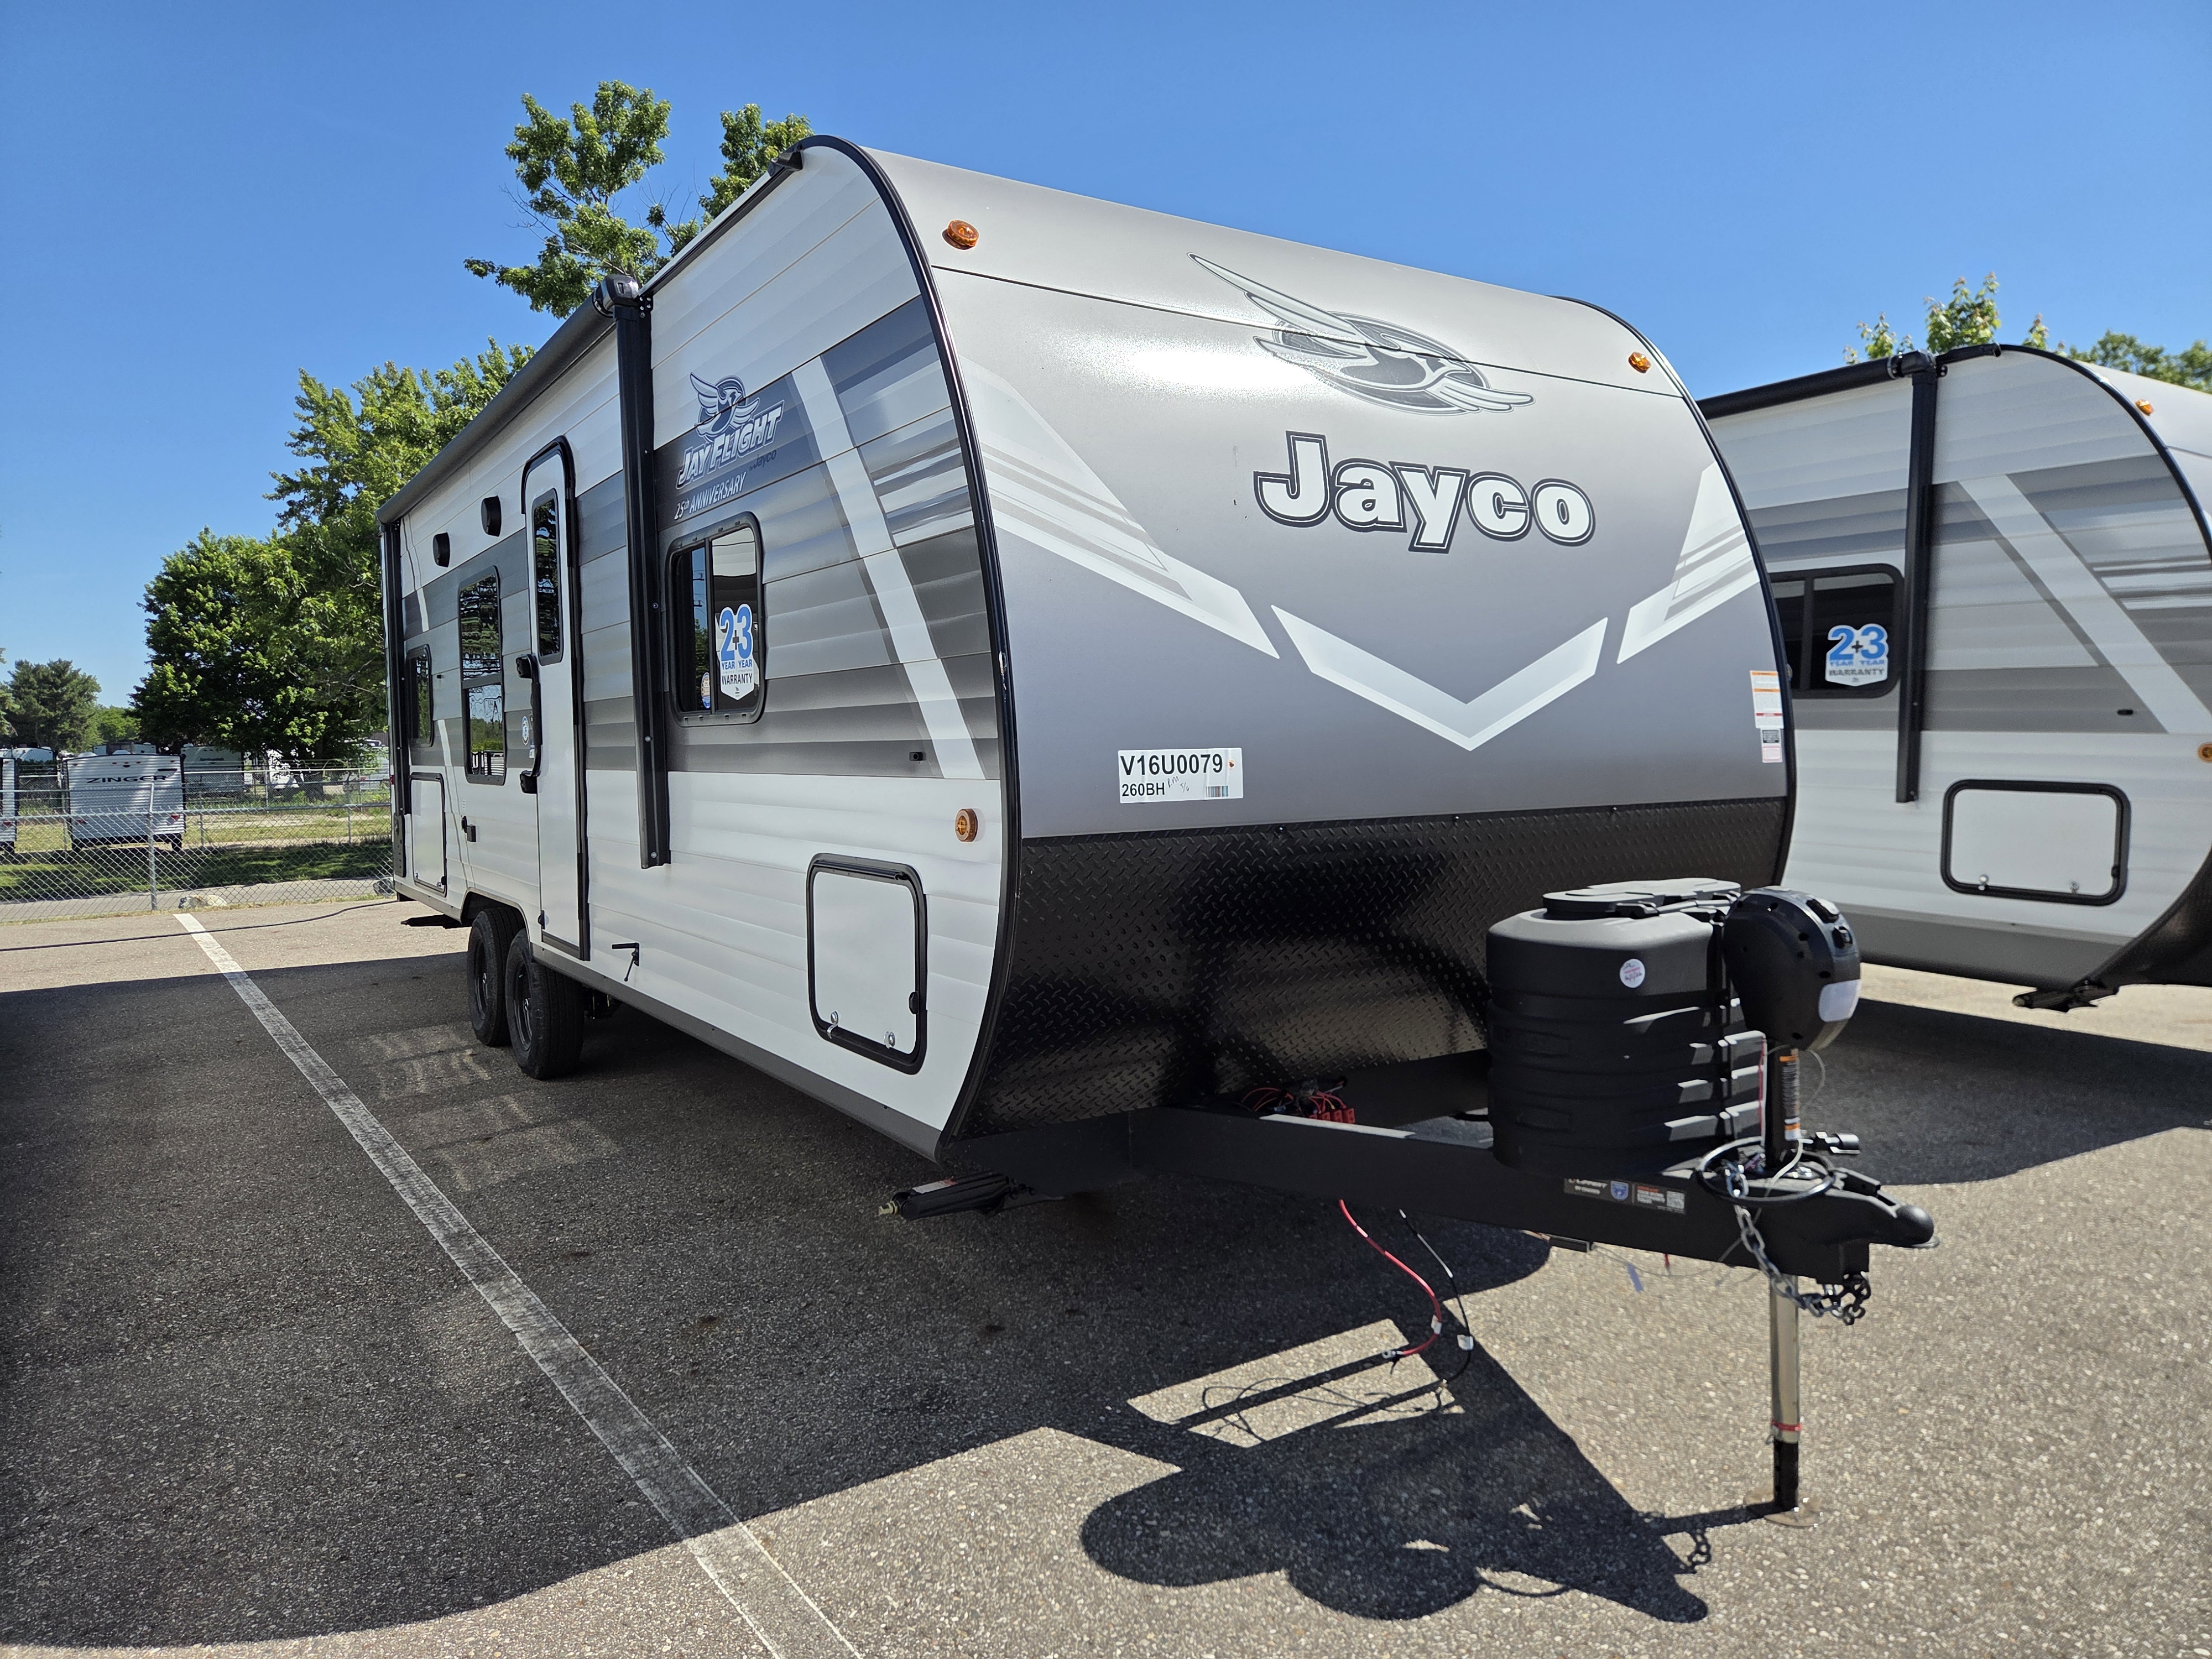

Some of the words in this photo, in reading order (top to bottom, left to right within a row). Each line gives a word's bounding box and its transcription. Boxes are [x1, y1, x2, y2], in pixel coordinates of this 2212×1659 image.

[676, 443, 712, 488] JAY
[708, 404, 783, 471] FLIGHT
[753, 449, 777, 469] Jayco
[674, 497, 690, 520] 25th
[689, 472, 747, 514] ANNIVERSARY
[1254, 431, 1595, 554] Jayco
[722, 661, 735, 670] YEAR
[738, 659, 753, 668] YEAR
[722, 673, 753, 685] WARRANTY
[1120, 754, 1223, 775] V16U0079
[1121, 782, 1165, 796] 260BH
